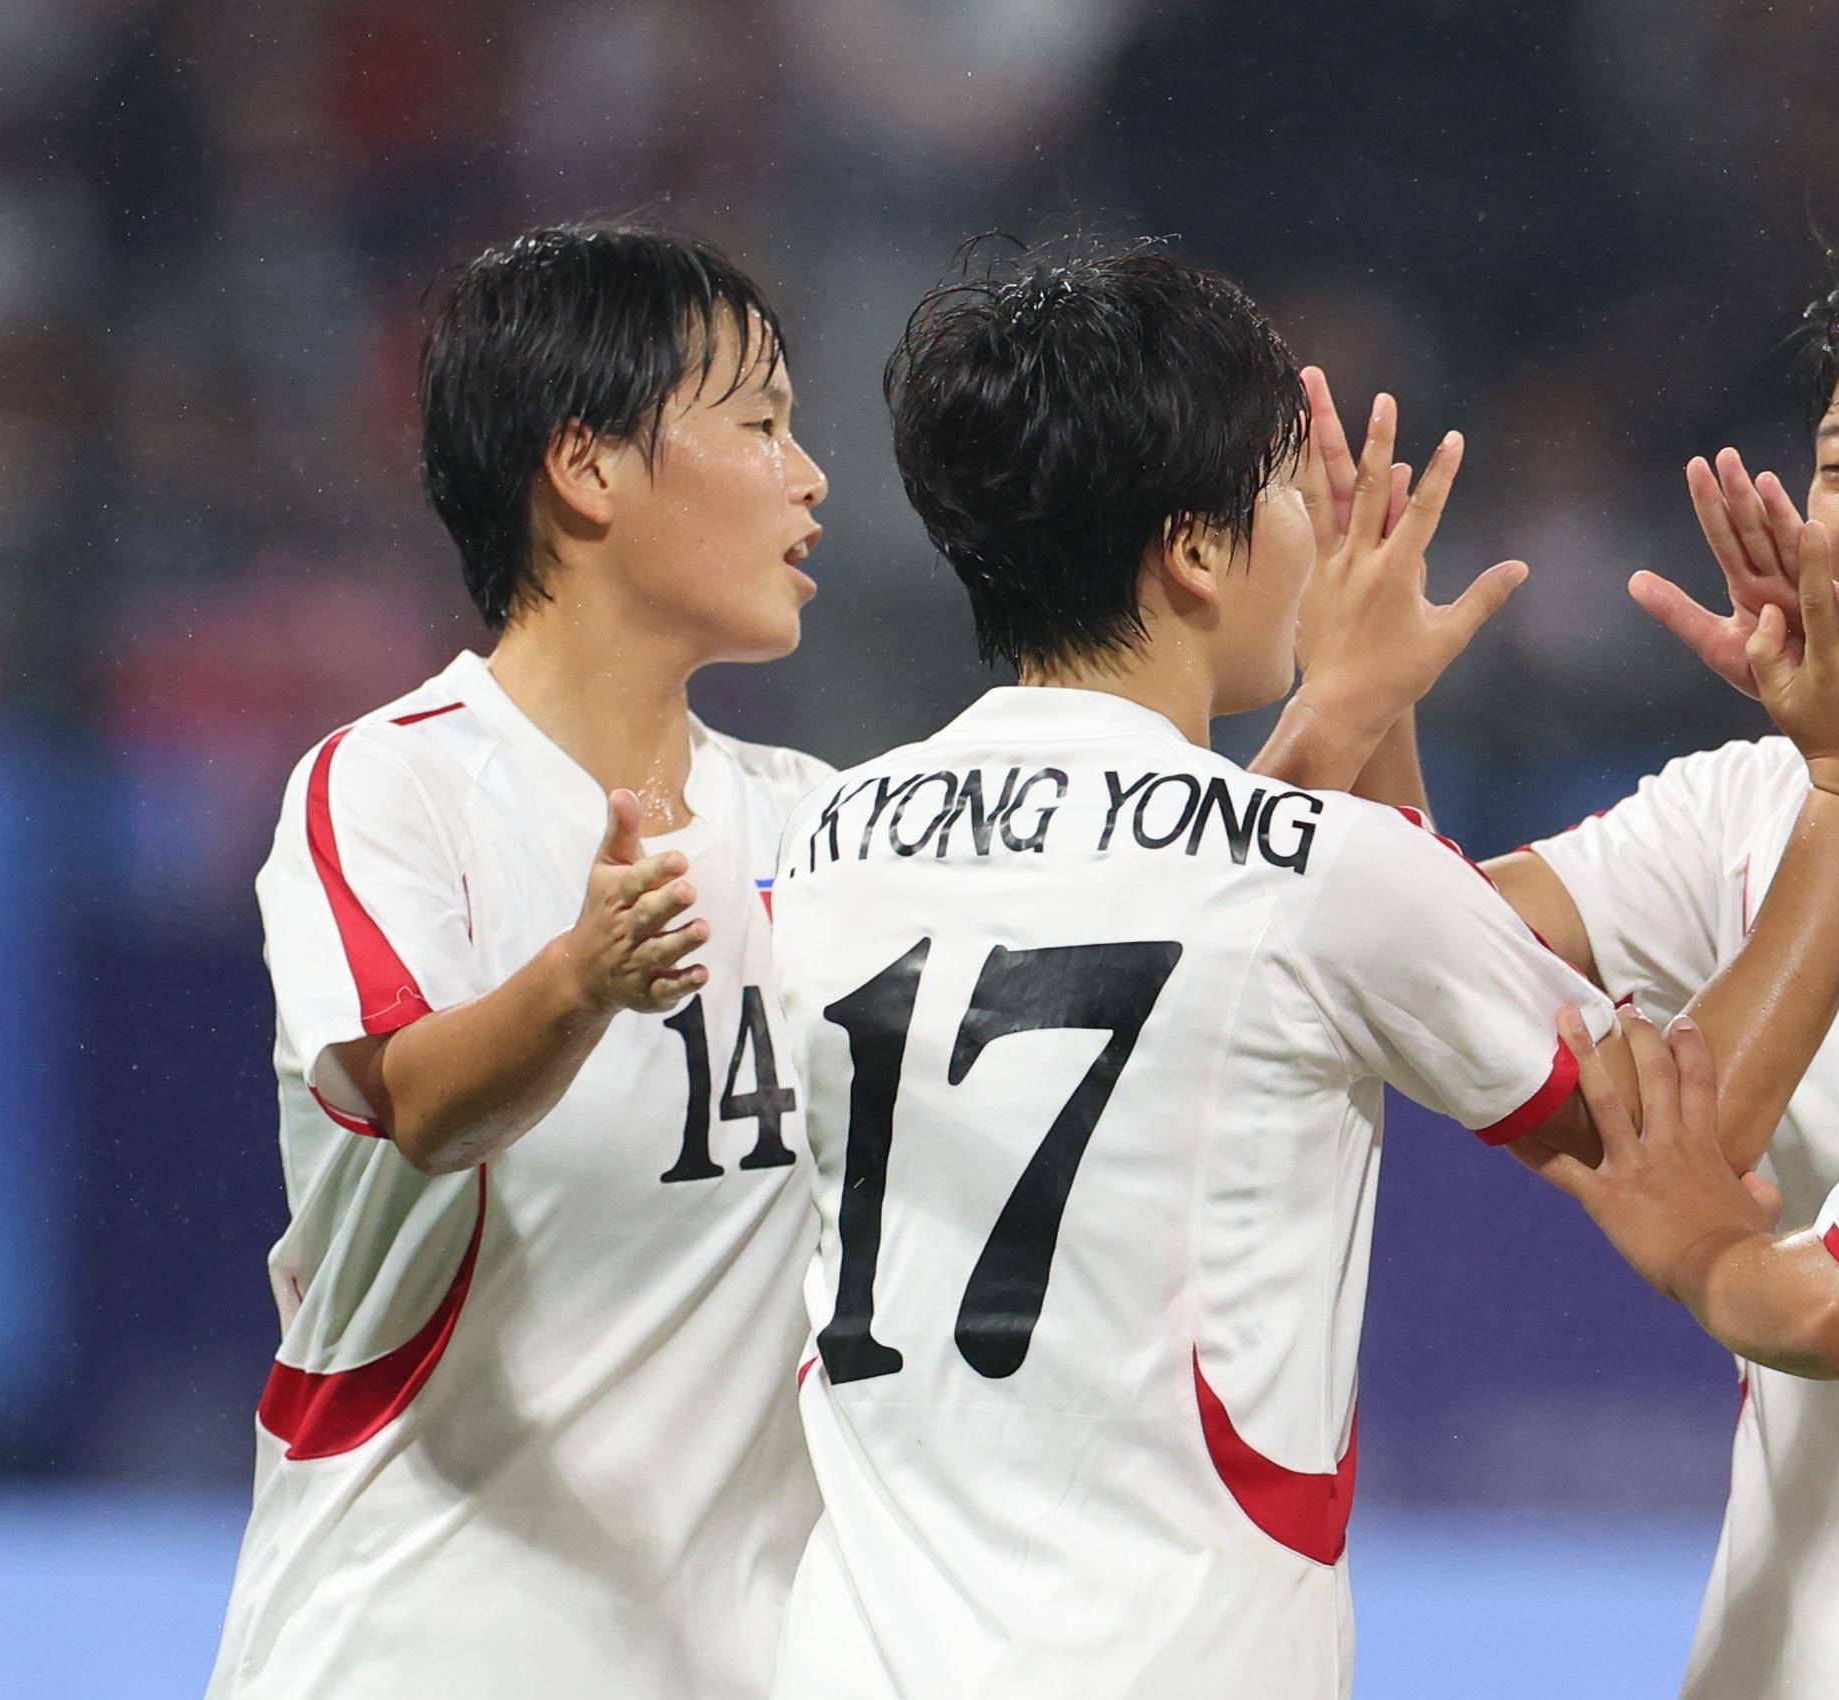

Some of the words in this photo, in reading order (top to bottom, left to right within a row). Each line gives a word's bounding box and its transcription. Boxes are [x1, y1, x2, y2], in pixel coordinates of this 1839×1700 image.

[1096, 770, 1325, 876] YONG
[660, 985, 797, 1184] 14
[822, 936, 1183, 1386] 17
